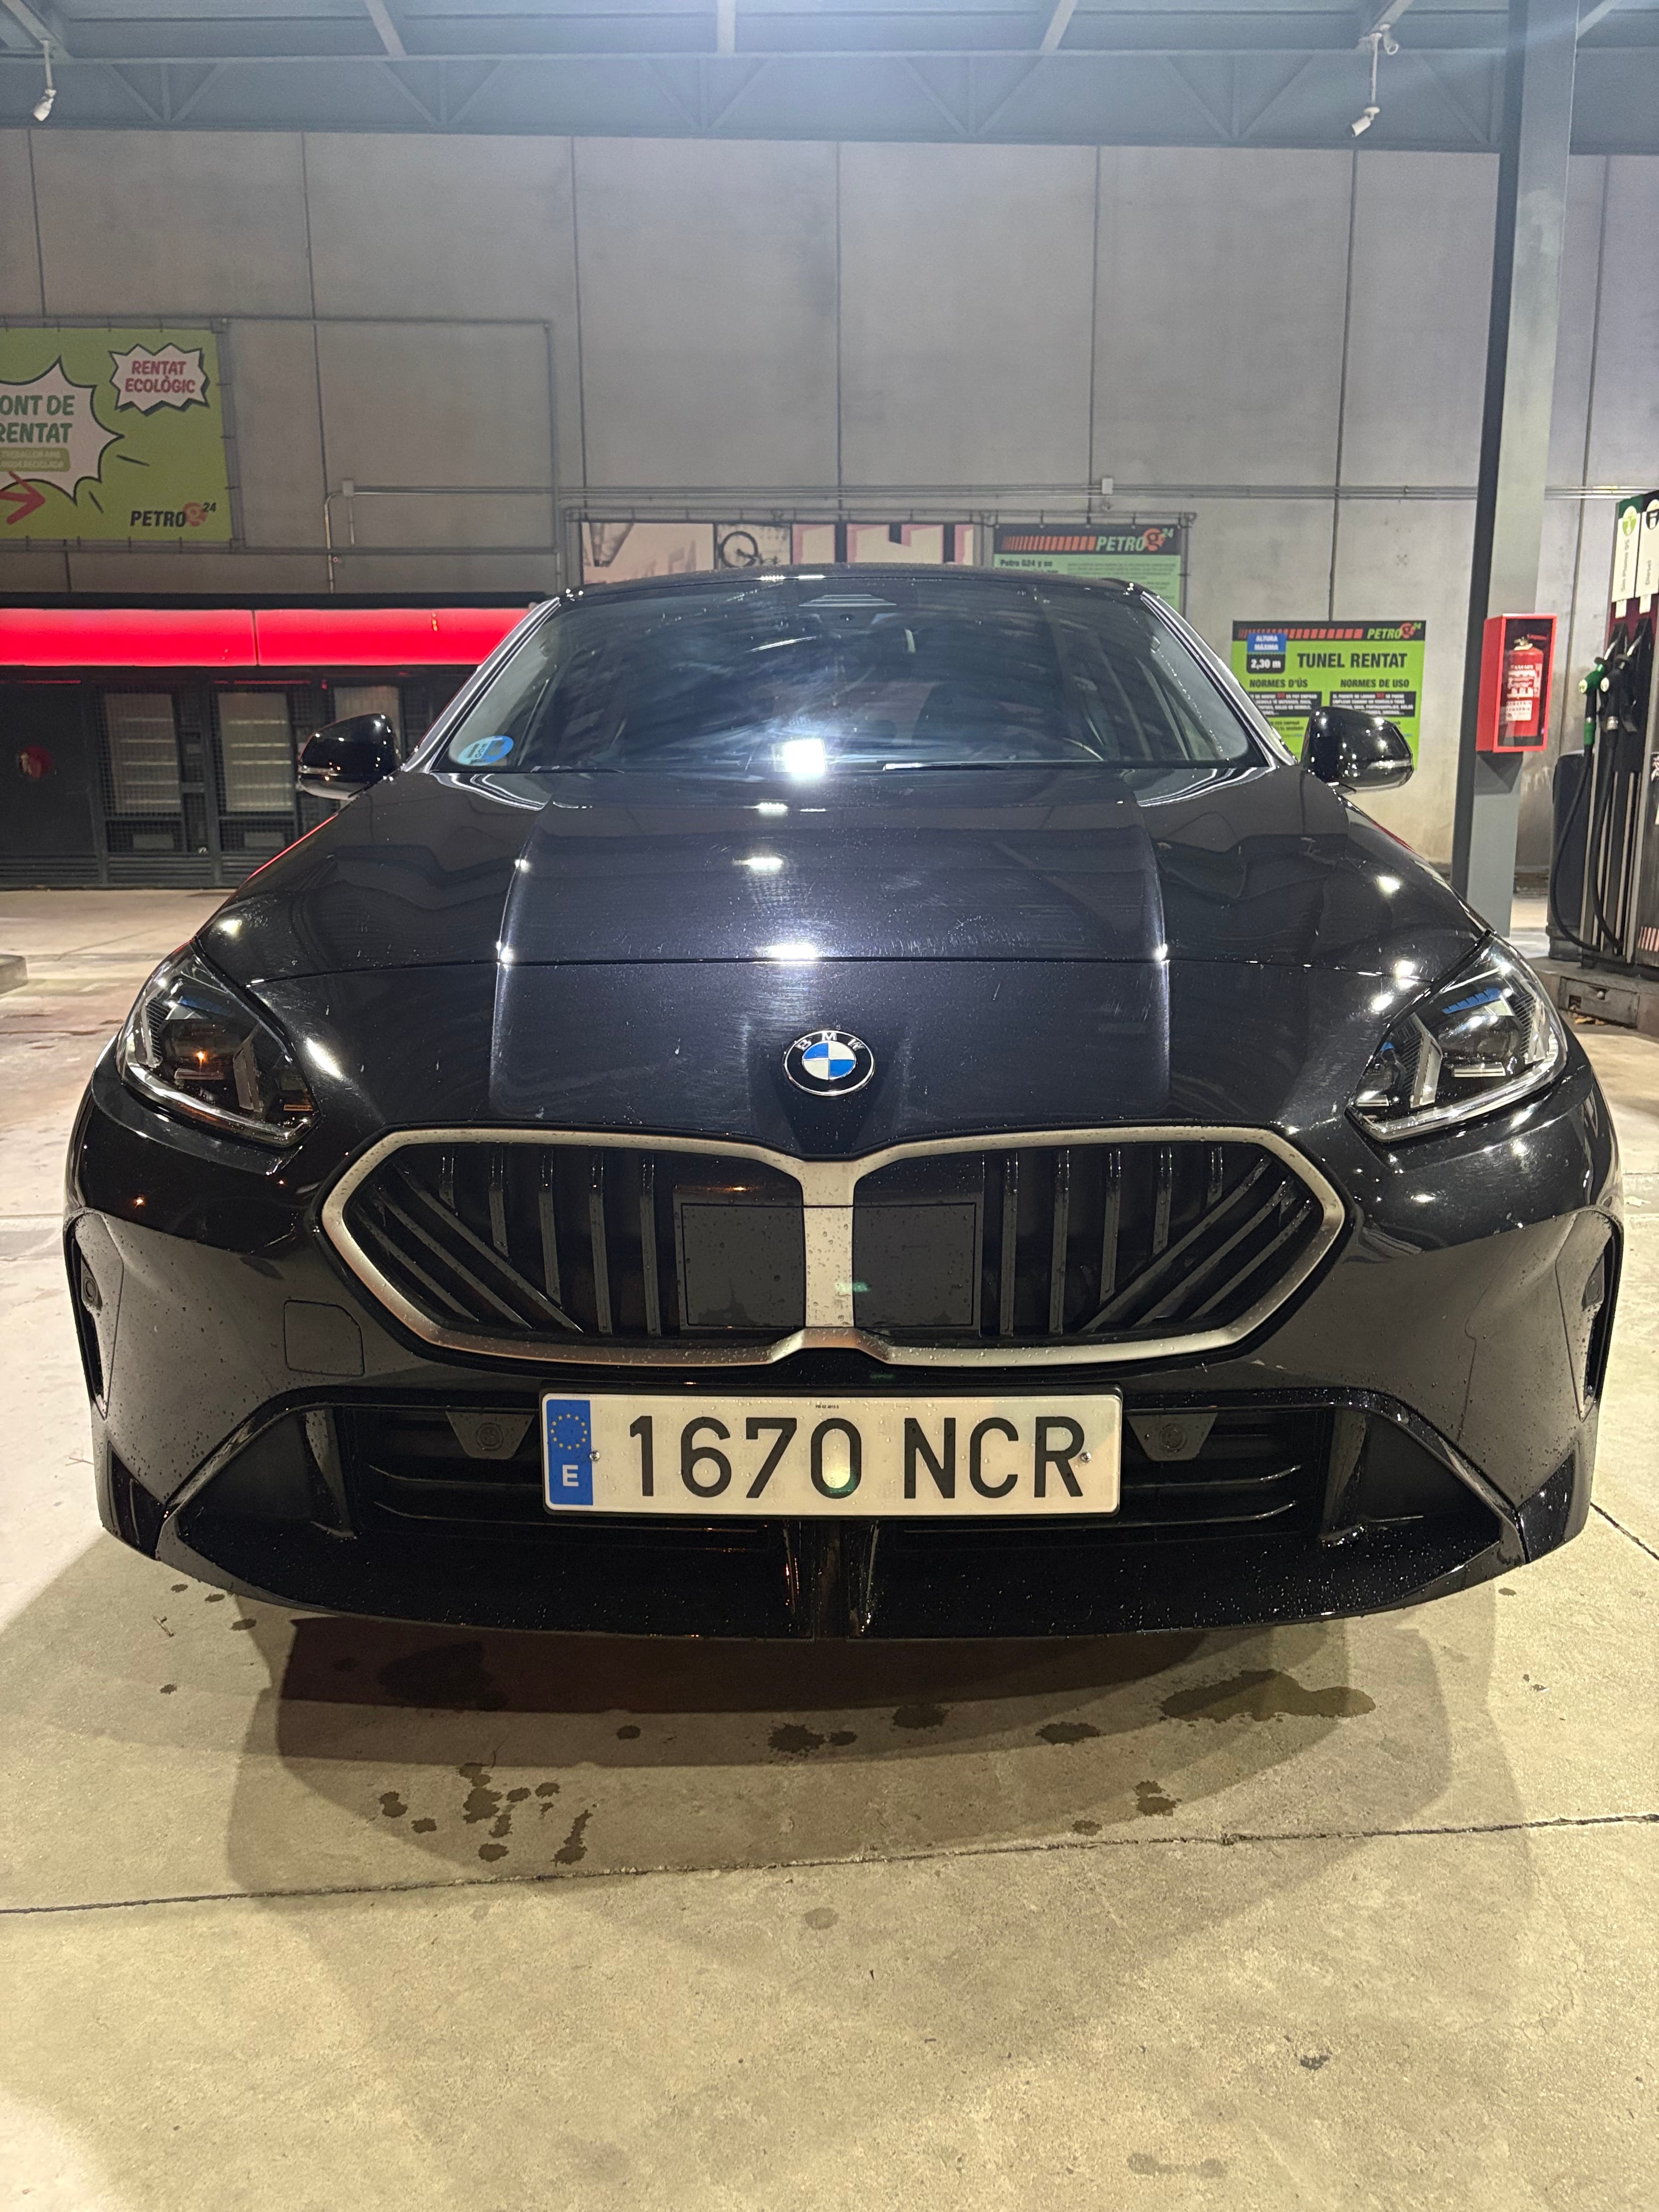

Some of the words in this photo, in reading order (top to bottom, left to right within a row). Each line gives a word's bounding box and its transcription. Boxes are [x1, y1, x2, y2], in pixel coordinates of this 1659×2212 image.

[132, 360, 186, 375] RENTAT
[125, 375, 196, 393] ECOLÒGIC
[47, 394, 75, 416] DE
[129, 510, 187, 527] PETRO
[1096, 535, 1146, 552] PETRO
[1366, 628, 1402, 640] PETRO
[1250, 658, 1271, 670] 2,30
[1272, 660, 1282, 669] m
[1297, 653, 1345, 668] TUNEL
[1350, 653, 1408, 668] RENTAT
[1249, 679, 1285, 688] NORMES
[1340, 679, 1376, 688] NORMES
[1378, 679, 1390, 688] DE
[1392, 679, 1410, 688] USO
[794, 1032, 866, 1052] BMW
[629, 1415, 862, 1499] 1670
[904, 1417, 1086, 1499] NCR
[562, 1464, 579, 1487] E
